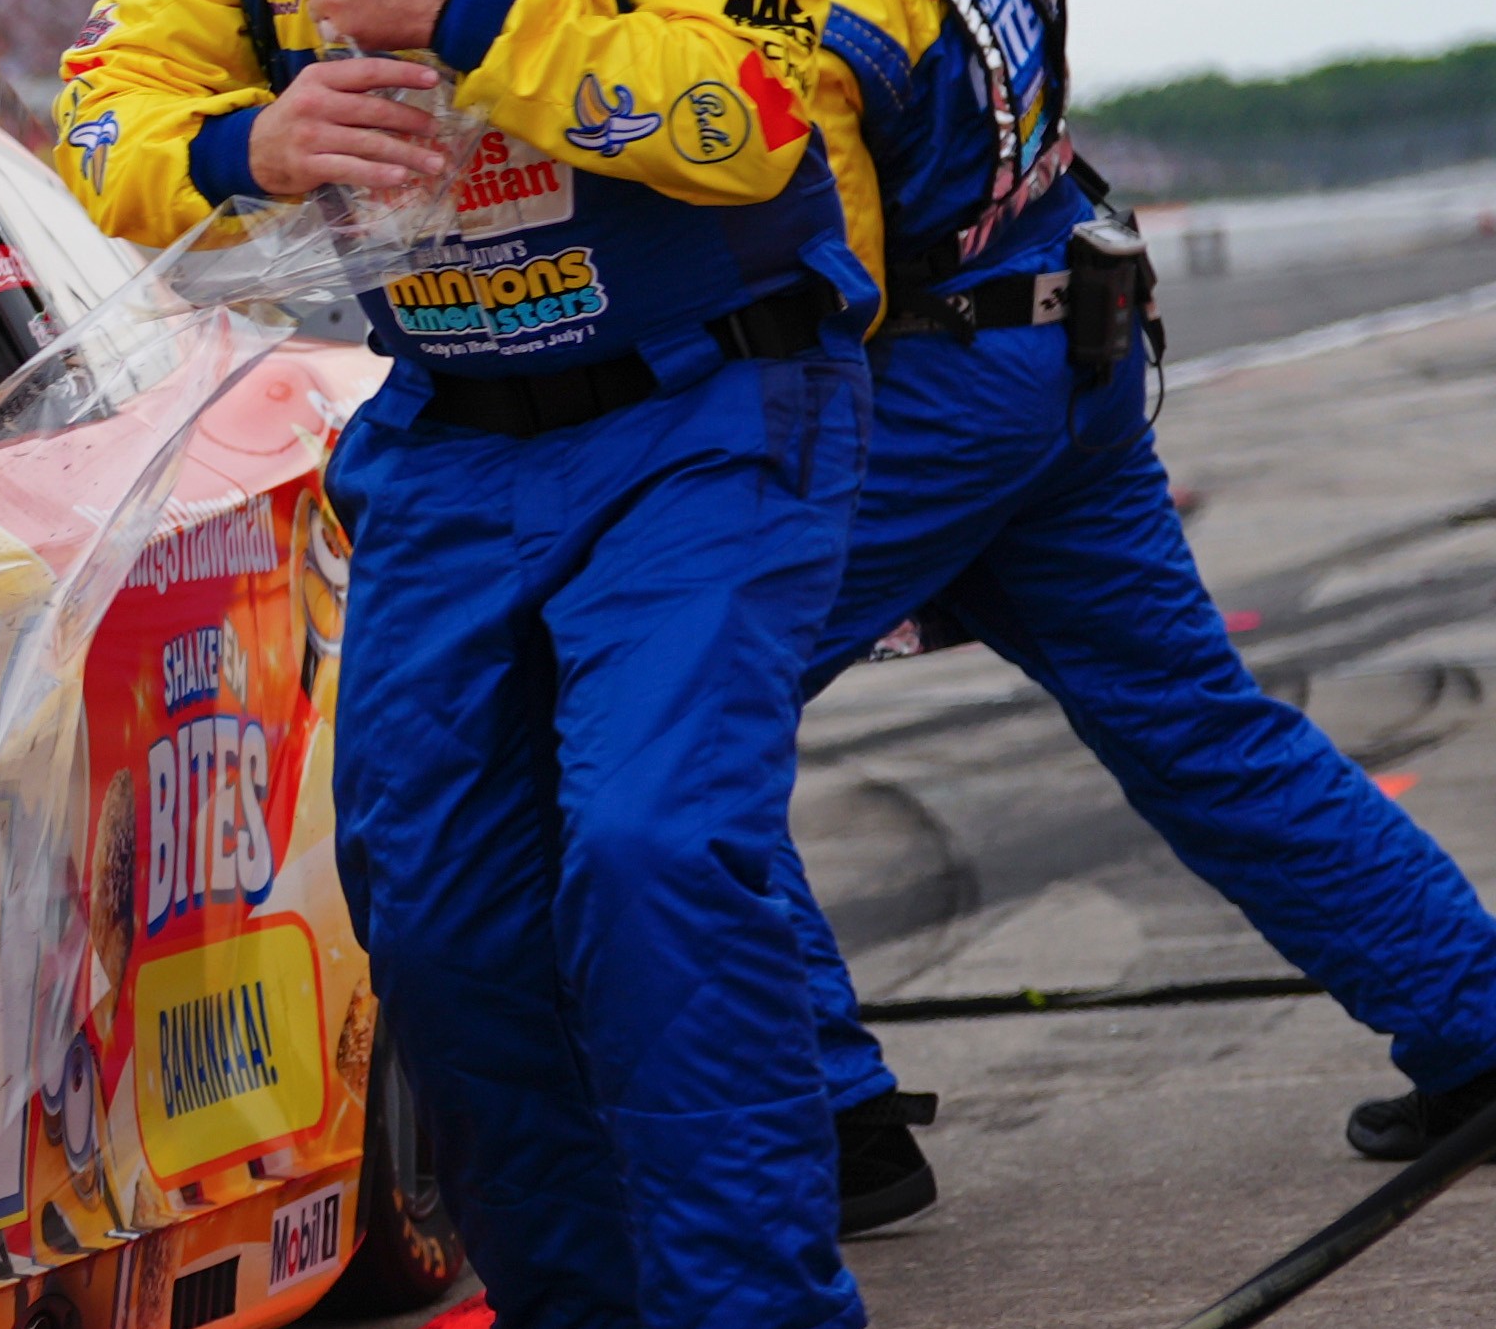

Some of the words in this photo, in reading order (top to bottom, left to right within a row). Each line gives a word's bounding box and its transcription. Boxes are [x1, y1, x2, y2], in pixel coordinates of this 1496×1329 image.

[163, 627, 222, 717] SHAKE
[146, 713, 274, 938] BITES
[269, 1200, 322, 1287] Mobil
[322, 1193, 340, 1262] 1
